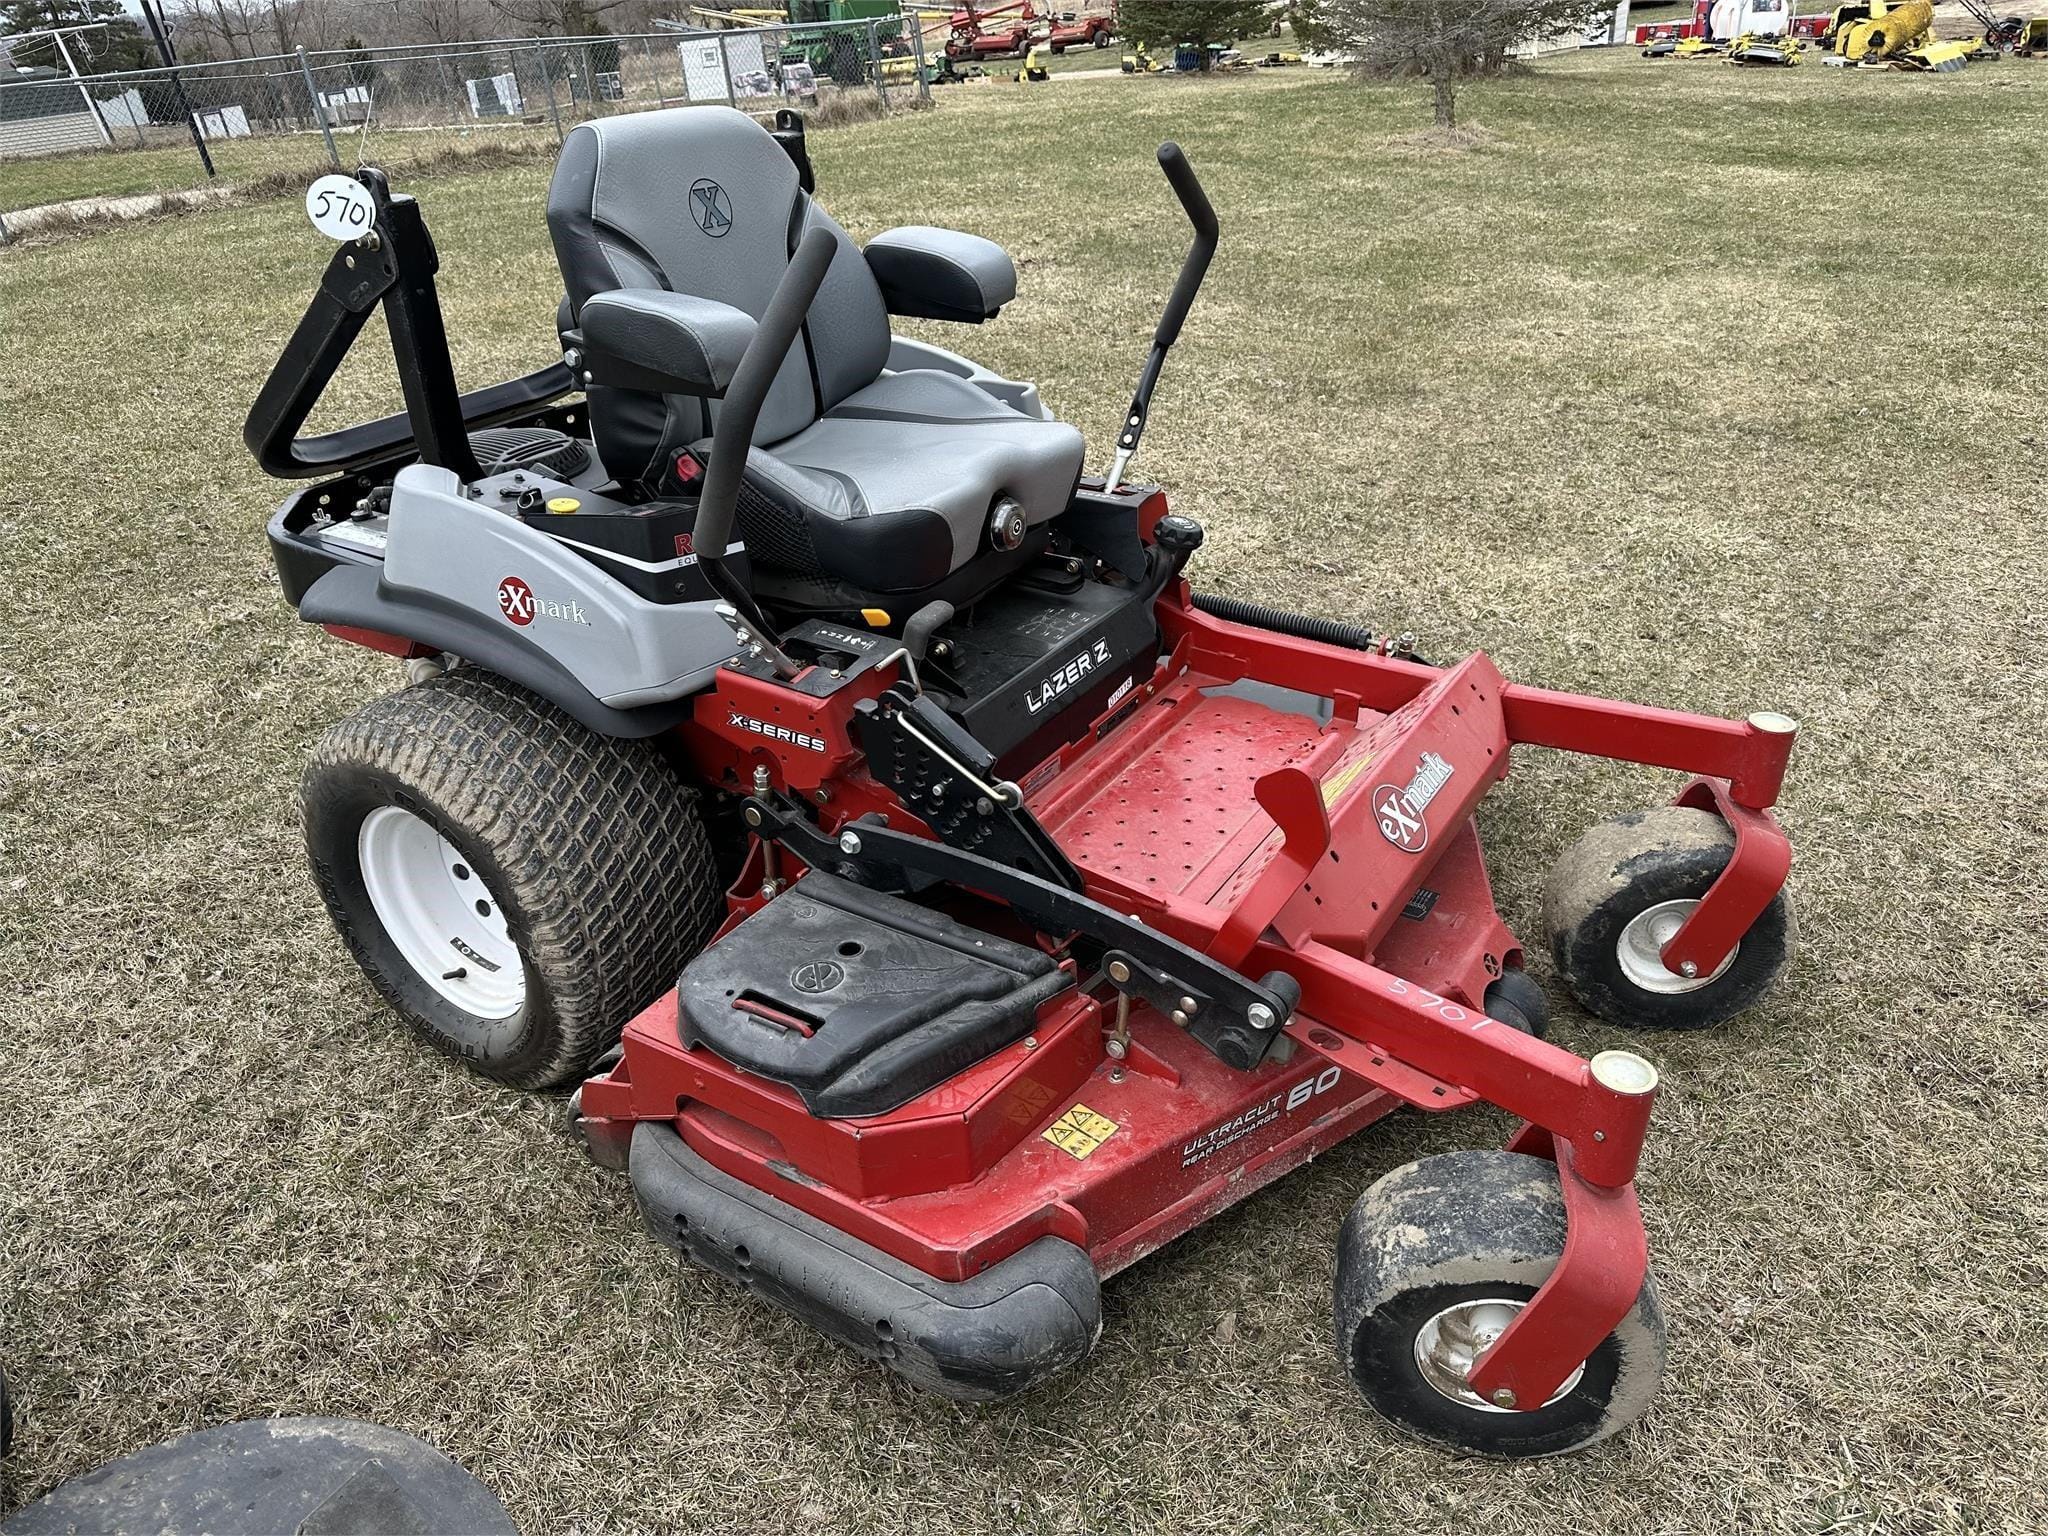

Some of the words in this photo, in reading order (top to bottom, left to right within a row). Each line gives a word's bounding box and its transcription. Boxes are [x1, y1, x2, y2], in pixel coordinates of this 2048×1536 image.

[315, 190, 373, 230] 5701
[497, 583, 588, 625] eXmark
[1025, 651, 1094, 714] LAZER
[1093, 639, 1110, 665] Z
[729, 712, 826, 753] X-SERIES
[1380, 752, 1453, 845] eXmark
[1387, 978, 1494, 1031] 5701
[1182, 1145, 1213, 1168] REAR
[1215, 1109, 1280, 1150] DISCHARGE
[1183, 1094, 1282, 1156] ULTRACUT
[1286, 1065, 1342, 1111] 60
